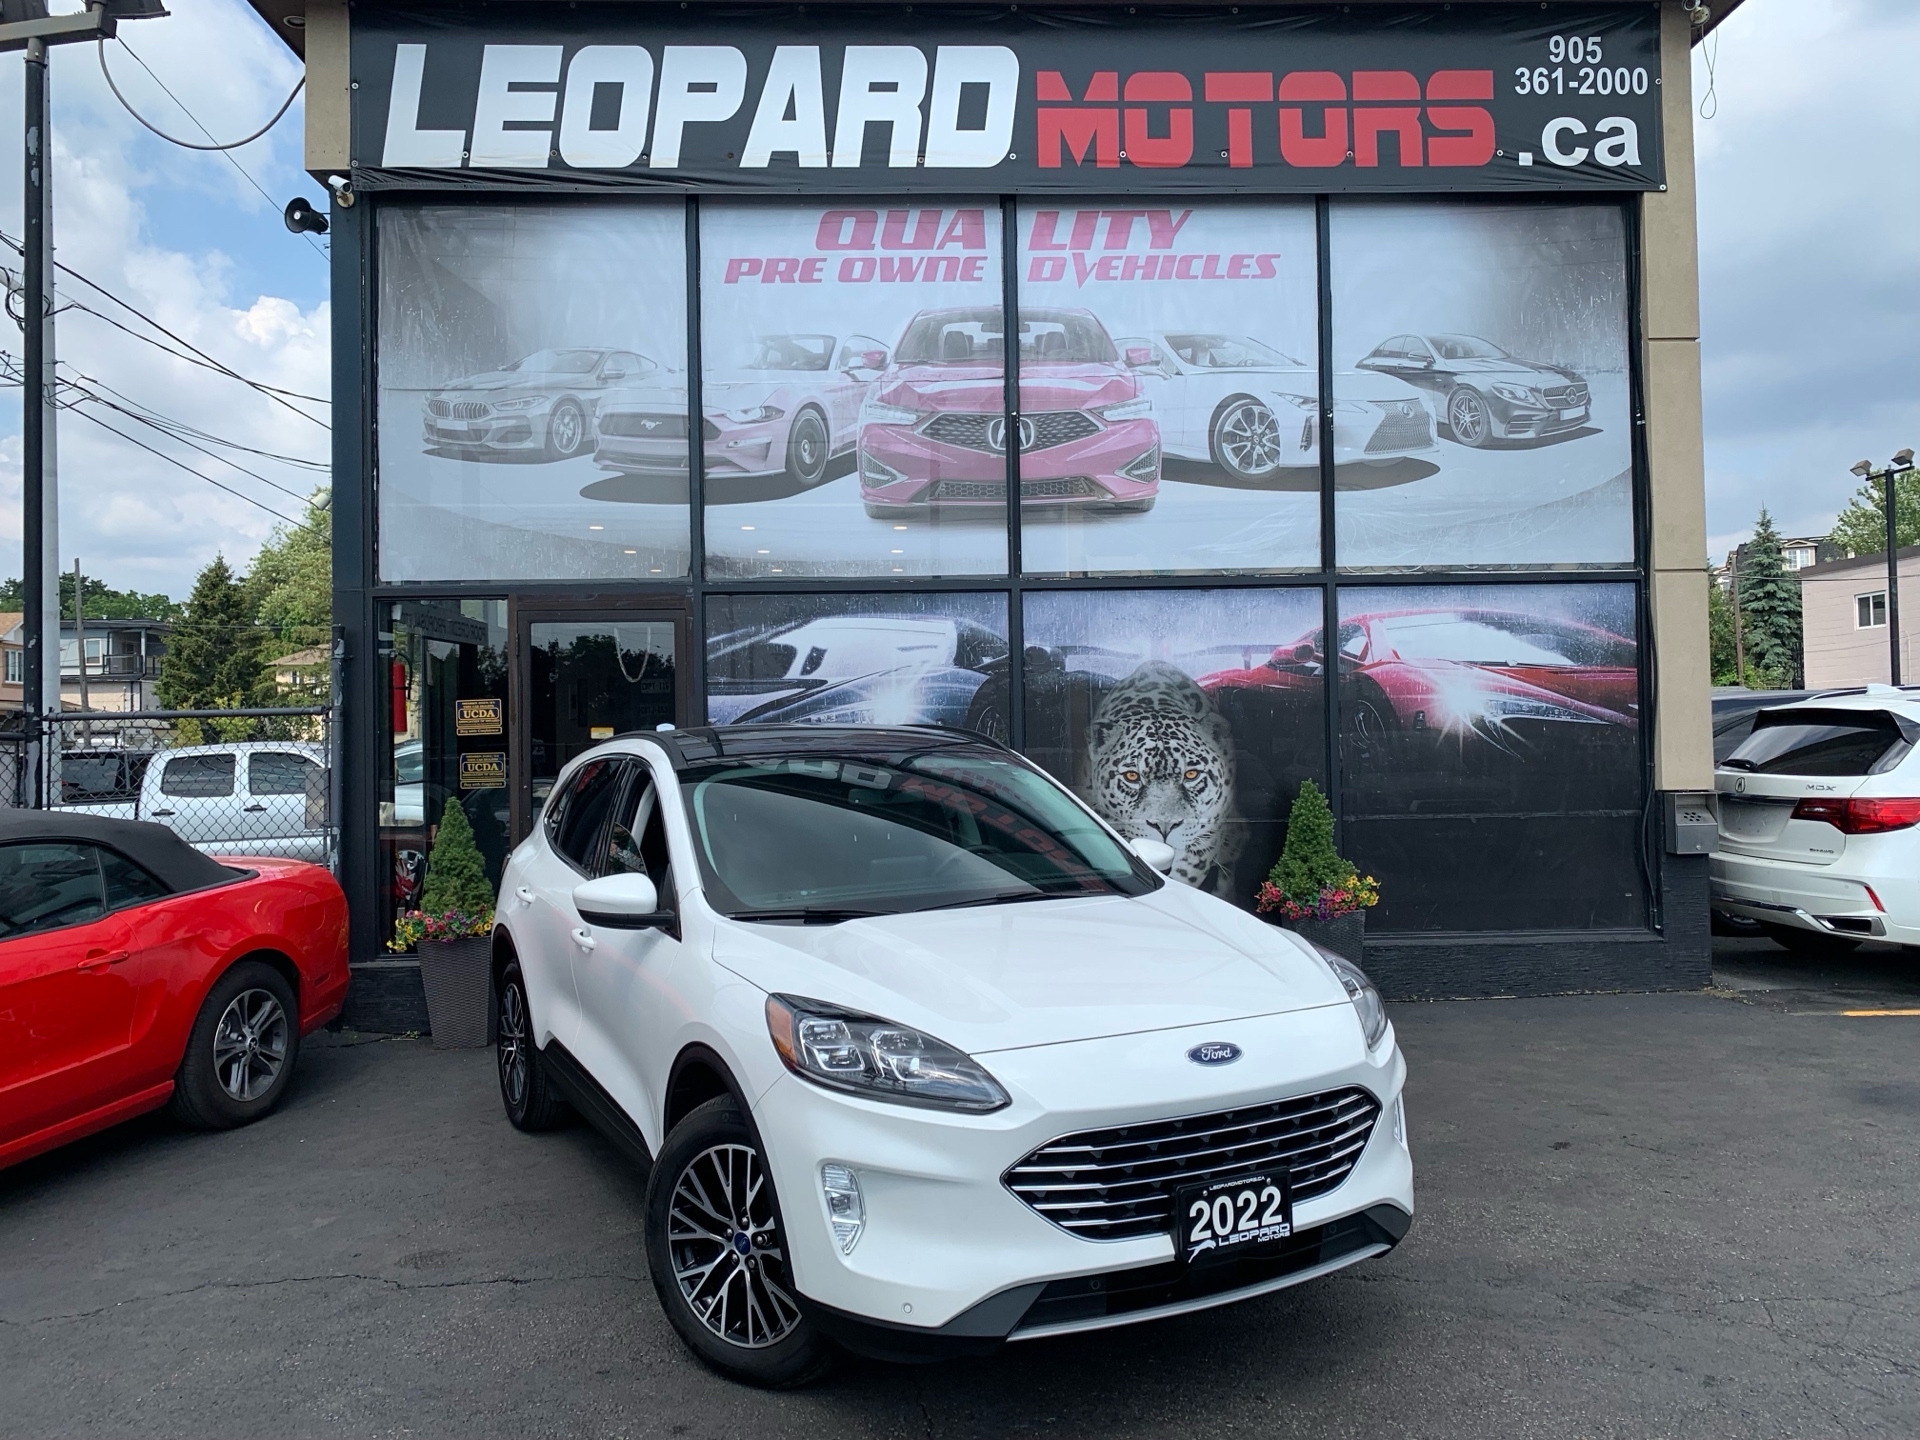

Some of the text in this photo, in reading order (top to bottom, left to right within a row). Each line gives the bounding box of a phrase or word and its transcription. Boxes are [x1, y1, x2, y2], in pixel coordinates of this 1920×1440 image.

[1549, 35, 1602, 64] 905
[1514, 67, 1649, 95] 361-2000
[381, 44, 1496, 168] LEOPARD MOTORS
[724, 257, 828, 284] PRE
[463, 709, 495, 719] UCDA
[467, 763, 498, 772] UCDA
[1201, 1045, 1232, 1061] Ford
[1189, 1186, 1282, 1242] 2022
[1218, 1223, 1290, 1246] LEOPARD
[1258, 1231, 1290, 1242] MOTORS
